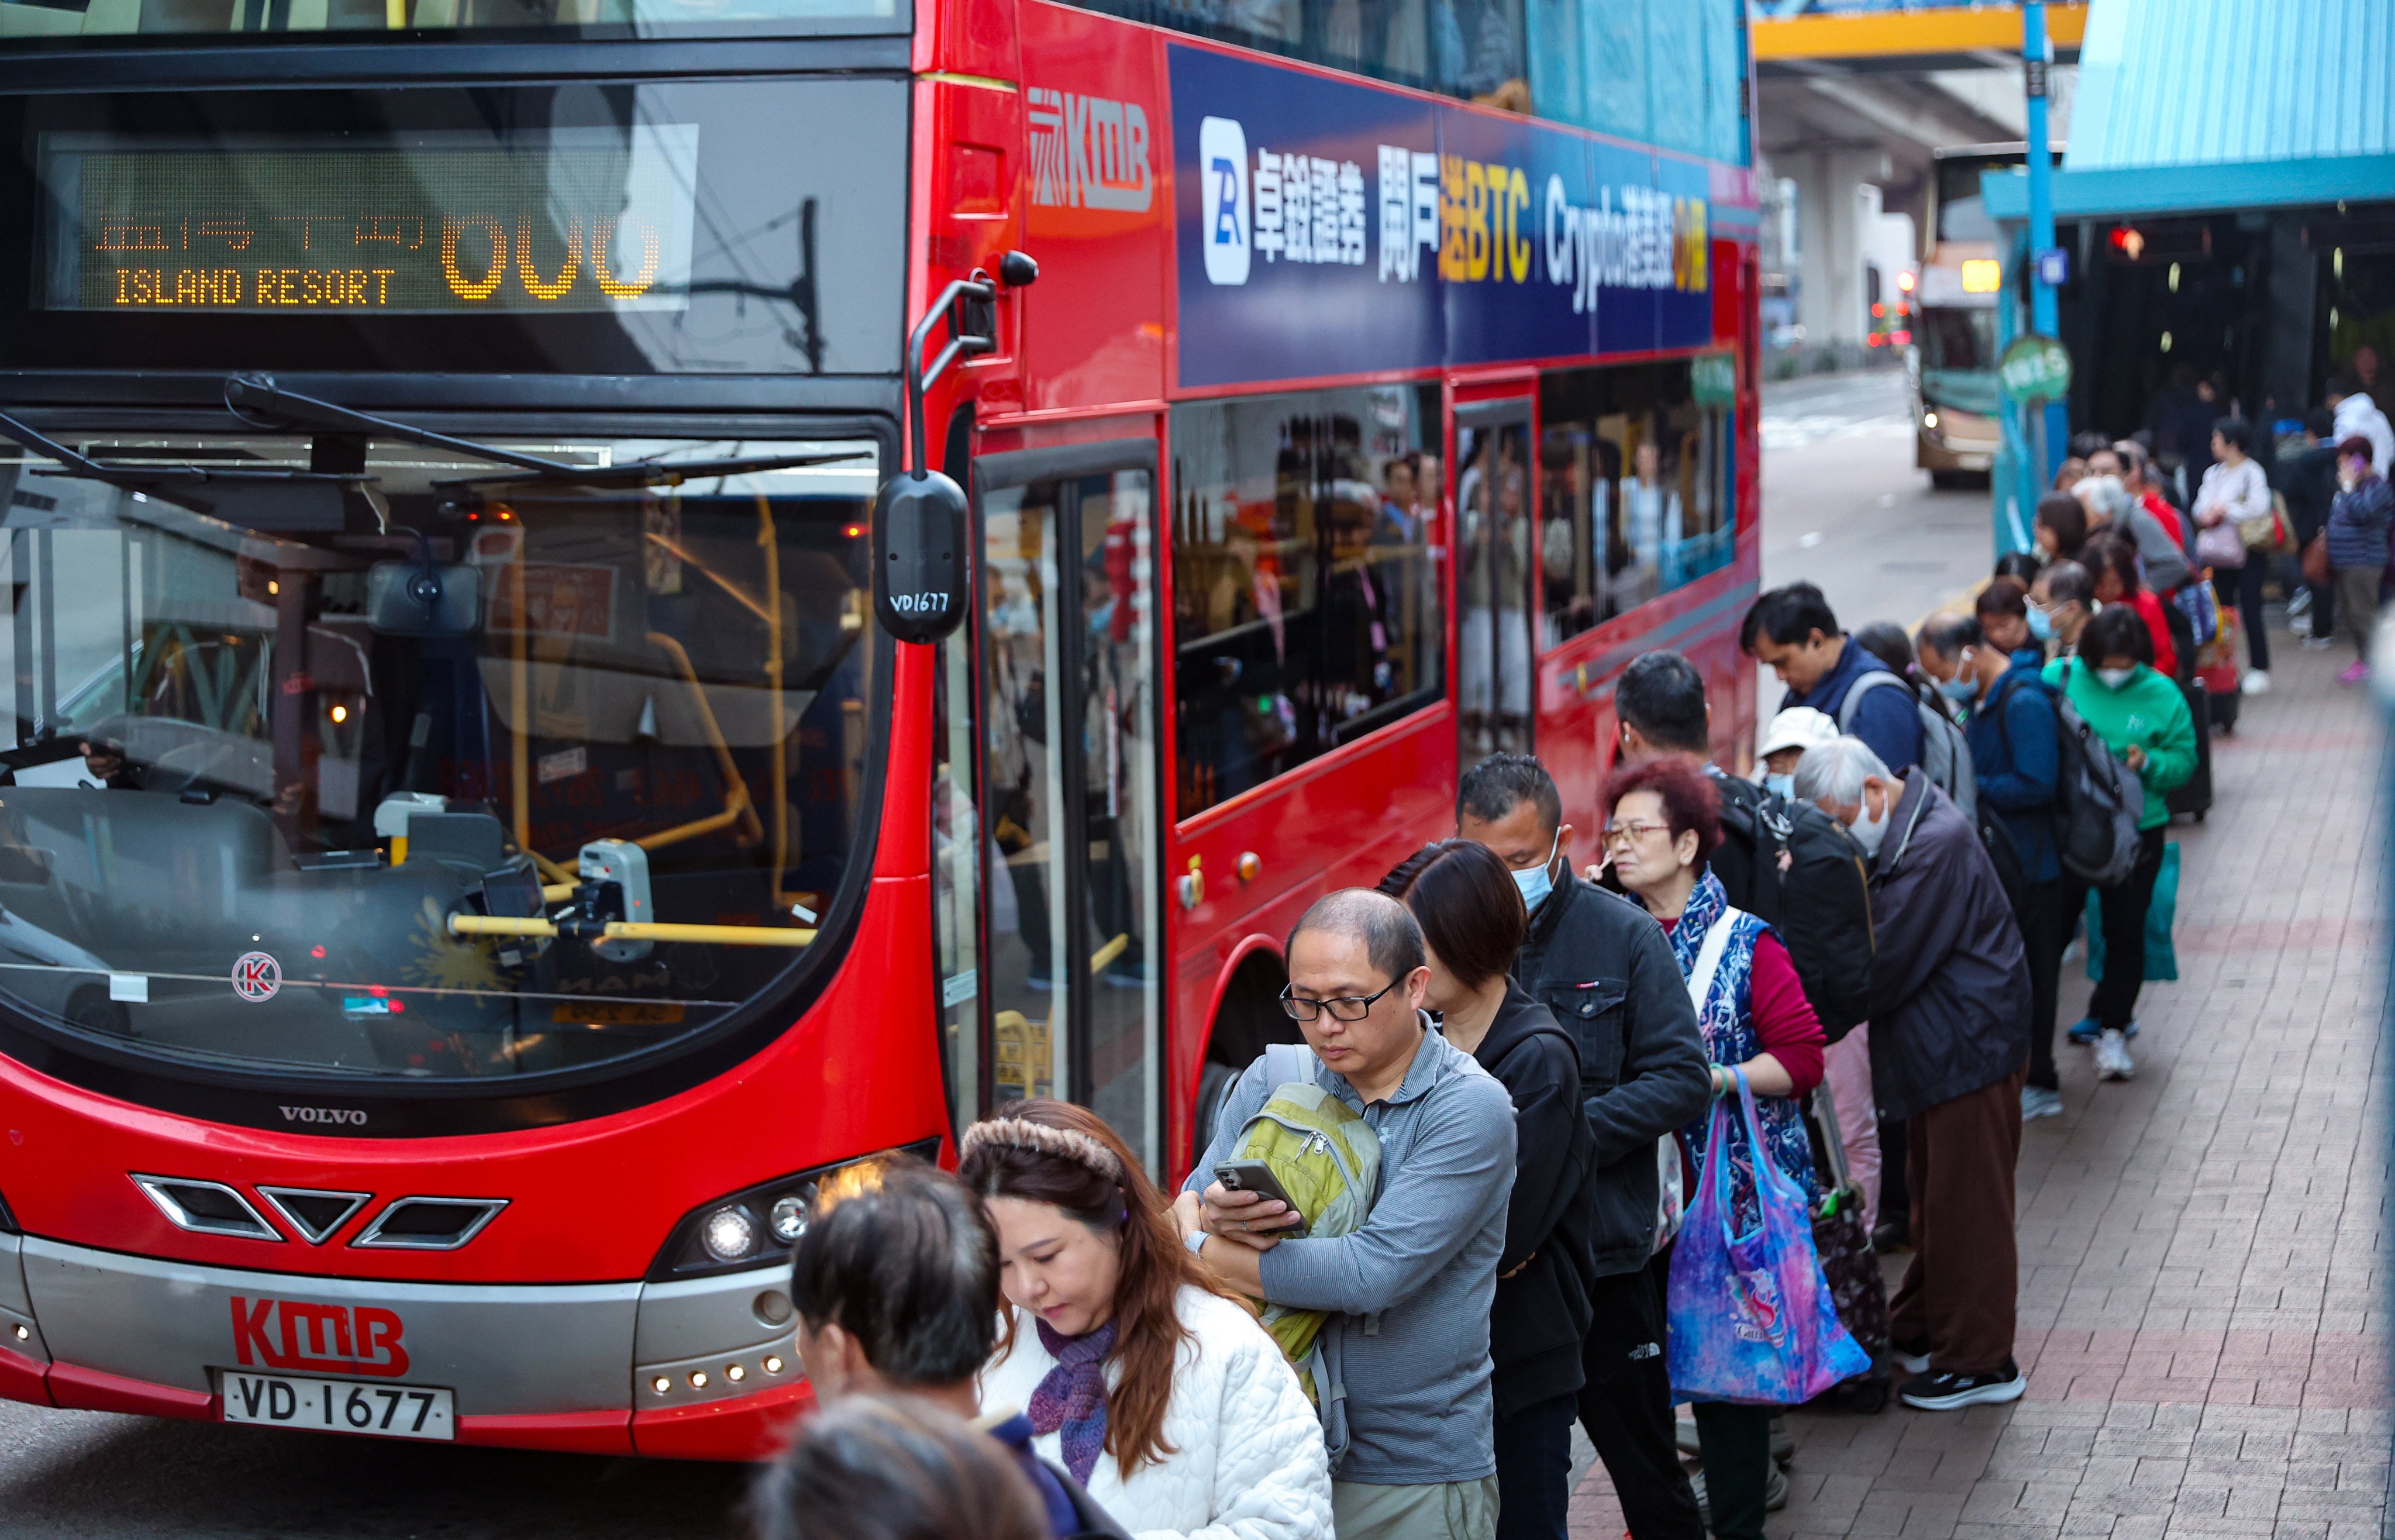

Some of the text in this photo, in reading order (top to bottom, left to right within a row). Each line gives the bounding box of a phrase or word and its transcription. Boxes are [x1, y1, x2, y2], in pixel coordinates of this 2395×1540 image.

[1064, 93, 1152, 213] KMB
[115, 269, 396, 305] ISLAND RESORT
[889, 592, 950, 614] VD1677
[278, 1105, 368, 1126] VOLVO
[230, 1296, 411, 1379] KMB
[237, 1377, 436, 1432] VD 1677
